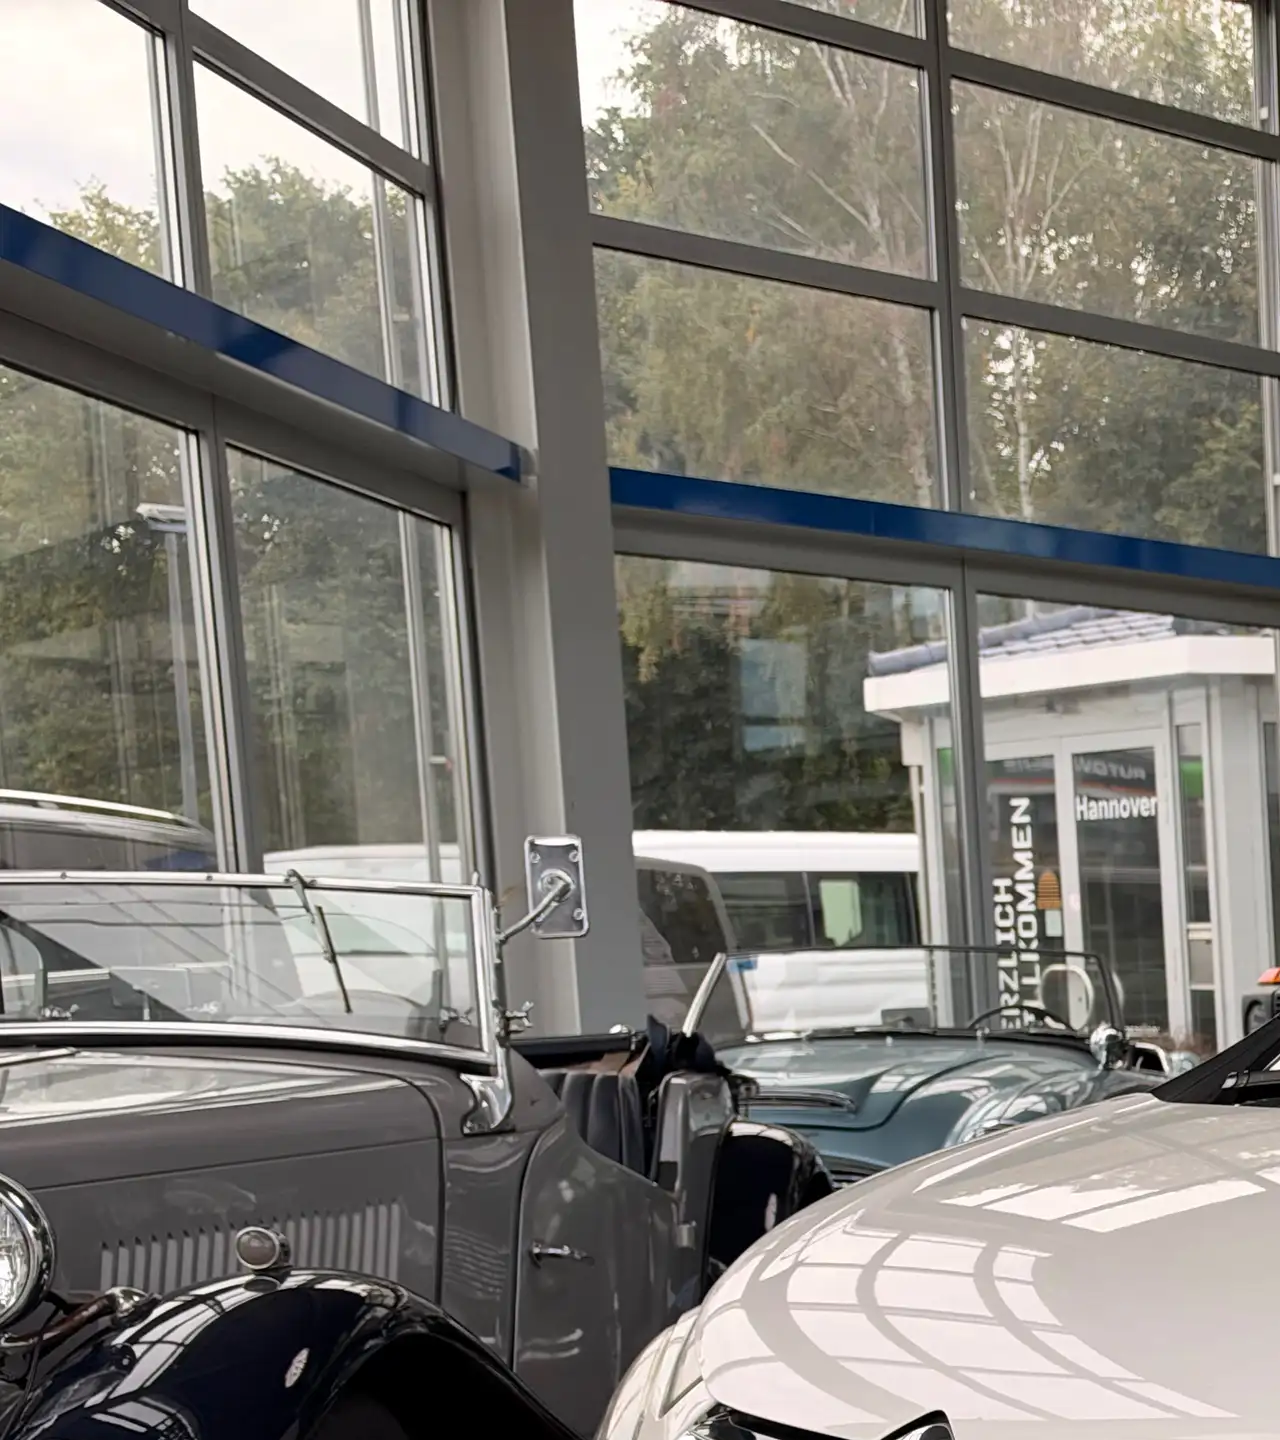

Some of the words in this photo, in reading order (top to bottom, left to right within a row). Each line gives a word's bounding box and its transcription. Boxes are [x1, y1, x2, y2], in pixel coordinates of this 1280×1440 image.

[1076, 795, 1157, 821] Hannover
[992, 877, 1021, 1029] ERZLICH
[1009, 797, 1041, 1027] ILLKOMMEN
